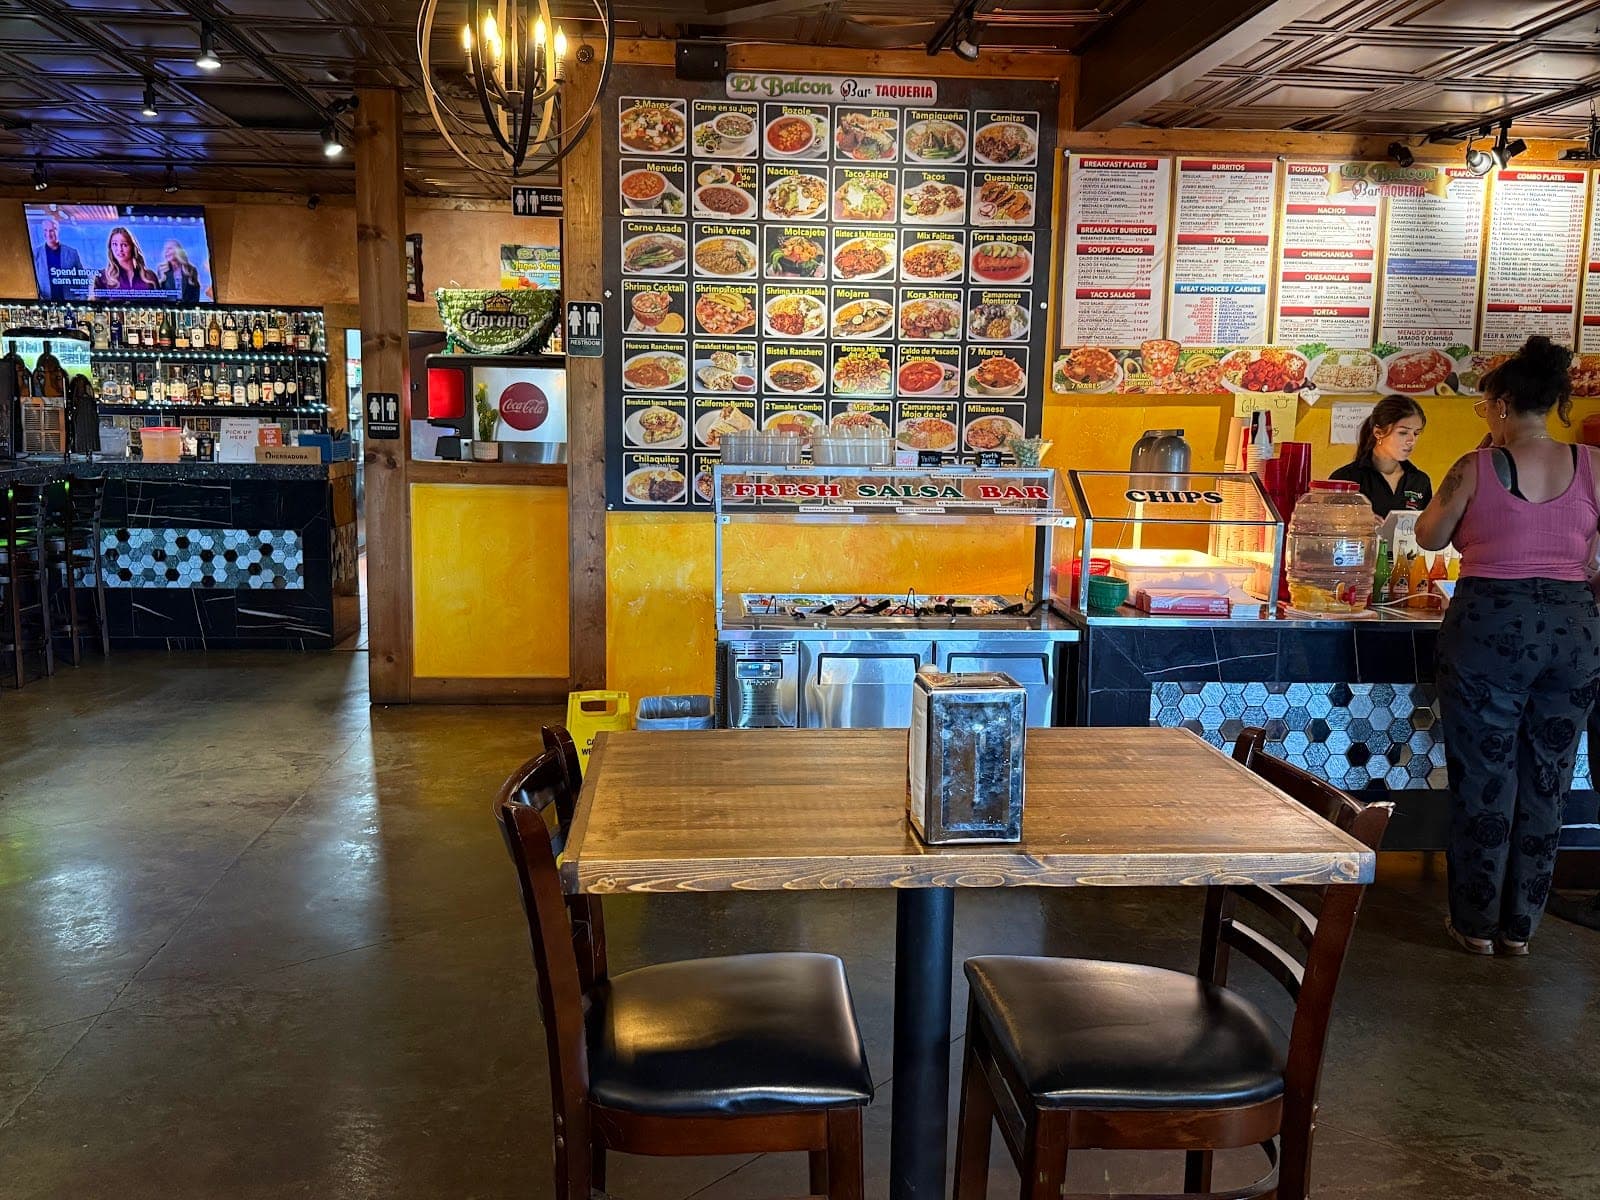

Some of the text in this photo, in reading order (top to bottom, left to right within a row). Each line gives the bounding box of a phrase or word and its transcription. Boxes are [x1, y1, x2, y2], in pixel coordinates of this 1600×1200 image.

[731, 75, 933, 101] El Balcon Bar TAQUERIA
[642, 100, 670, 109] Mares
[695, 103, 717, 111] Carne
[739, 105, 757, 115] Jugo
[782, 106, 811, 115] Pozole
[911, 111, 964, 122] Tampiqueña
[990, 113, 1025, 123] Carnitas
[646, 163, 683, 173] Menudo
[1123, 161, 1147, 169] PLATES
[737, 166, 755, 174] Birria
[767, 167, 799, 176] Nachos
[844, 170, 889, 179] Taco Salad
[922, 172, 945, 181] Tacos
[984, 174, 1034, 183] Quesabirria
[1010, 182, 1033, 191] Tacos
[1380, 185, 1425, 198] TAQUERIA
[540, 194, 562, 202] RESTR
[628, 223, 682, 233] Carne Asada
[702, 226, 751, 236] Chile Verde
[784, 227, 825, 238] Molcajete
[866, 231, 894, 239] Mexicana
[917, 232, 955, 241] Mix Fajitas
[973, 233, 1034, 243] Torta ahogada
[51, 267, 102, 277] Spend more,
[52, 277, 93, 285] earn more
[624, 283, 684, 293] Shrimp Cocktail
[695, 284, 756, 295] Shrimp Tostada
[766, 287, 790, 296] Shrimp
[836, 289, 869, 298] Mojarra
[907, 291, 958, 300] Kora Shrimp
[982, 291, 1021, 299] Camarones
[982, 298, 1019, 306] Monterrey
[460, 309, 529, 331] Corona
[625, 343, 650, 351] Huevos
[766, 347, 823, 356] Bistek Ranchero
[931, 348, 958, 356] Pescado
[971, 348, 976, 356] 7
[696, 400, 754, 409] California Burrito
[968, 405, 1005, 413] Milanesa
[633, 455, 680, 464] Chilaquiles
[734, 483, 1050, 500] FRESH SALSA BAR
[1125, 490, 1223, 504] CHIPS
